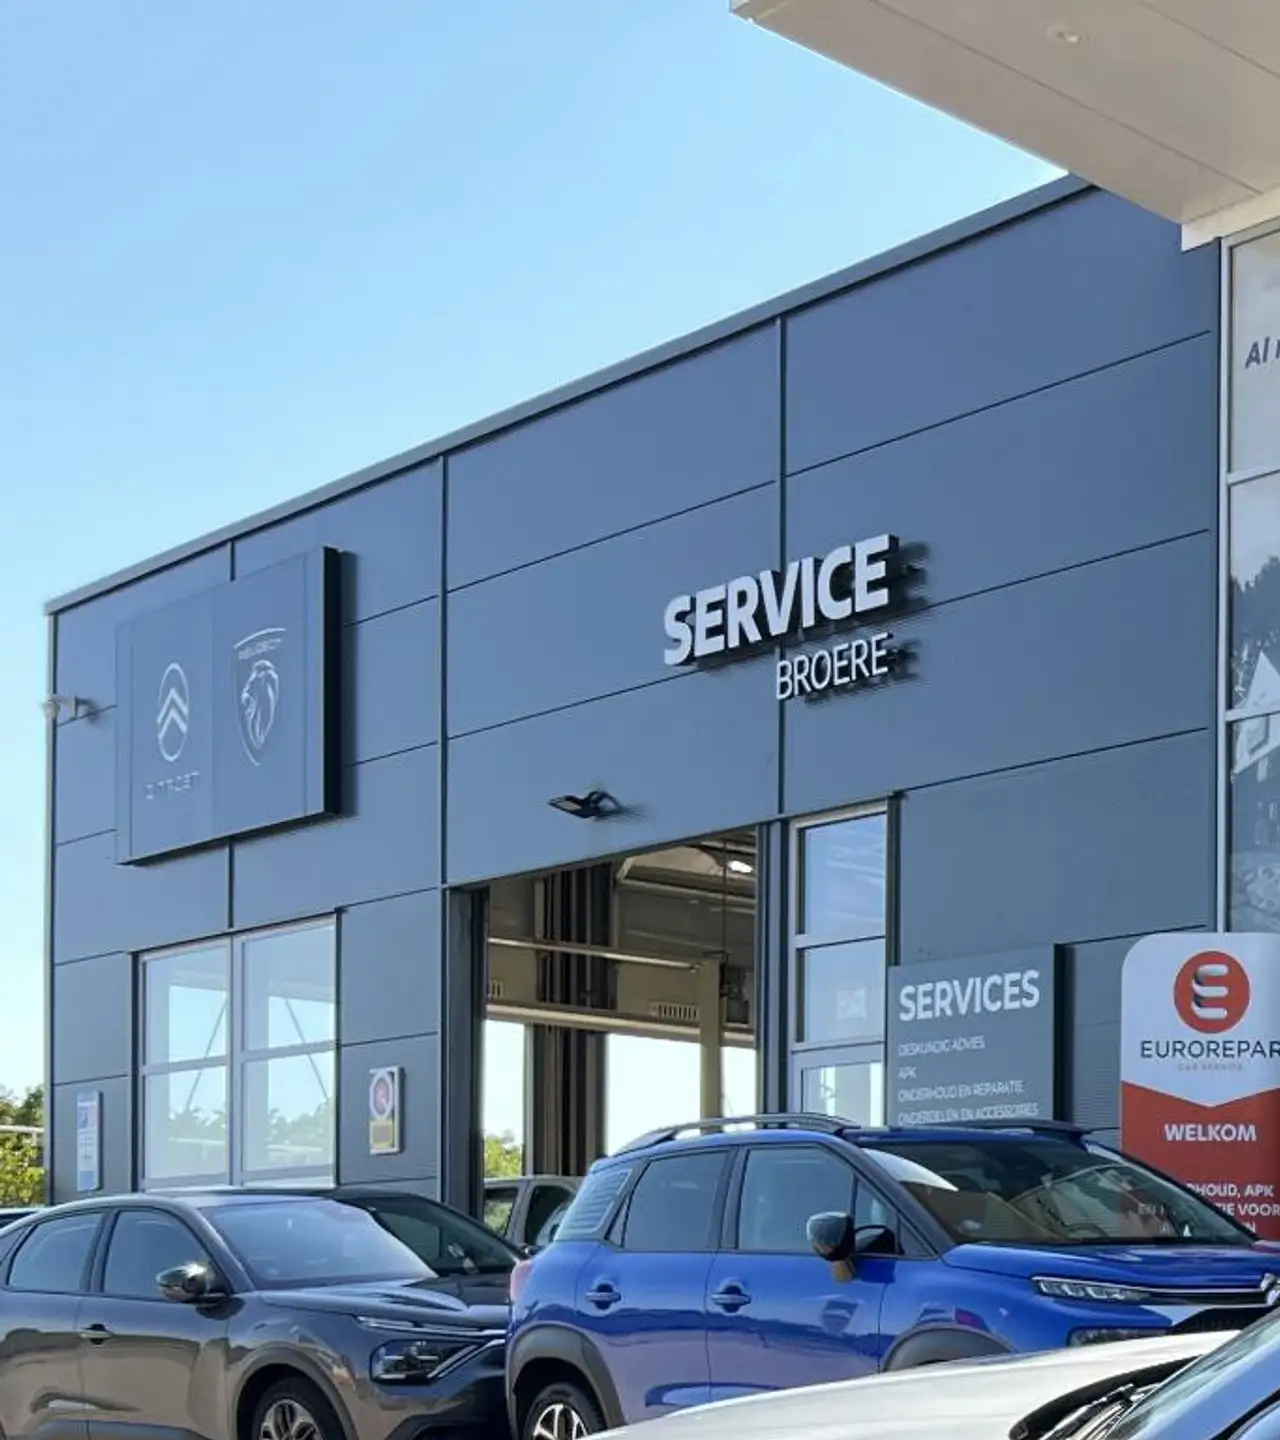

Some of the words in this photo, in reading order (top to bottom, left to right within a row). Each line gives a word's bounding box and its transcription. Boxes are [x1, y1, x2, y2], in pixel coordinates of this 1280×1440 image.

[1245, 337, 1270, 368] Al
[664, 534, 889, 666] SERVICE
[775, 632, 889, 700] BROERE
[900, 970, 1040, 1021] SERVICES
[1164, 1123, 1257, 1142] WELKOM
[1186, 1184, 1240, 1198] RHOUD,
[1244, 1185, 1275, 1197] APK
